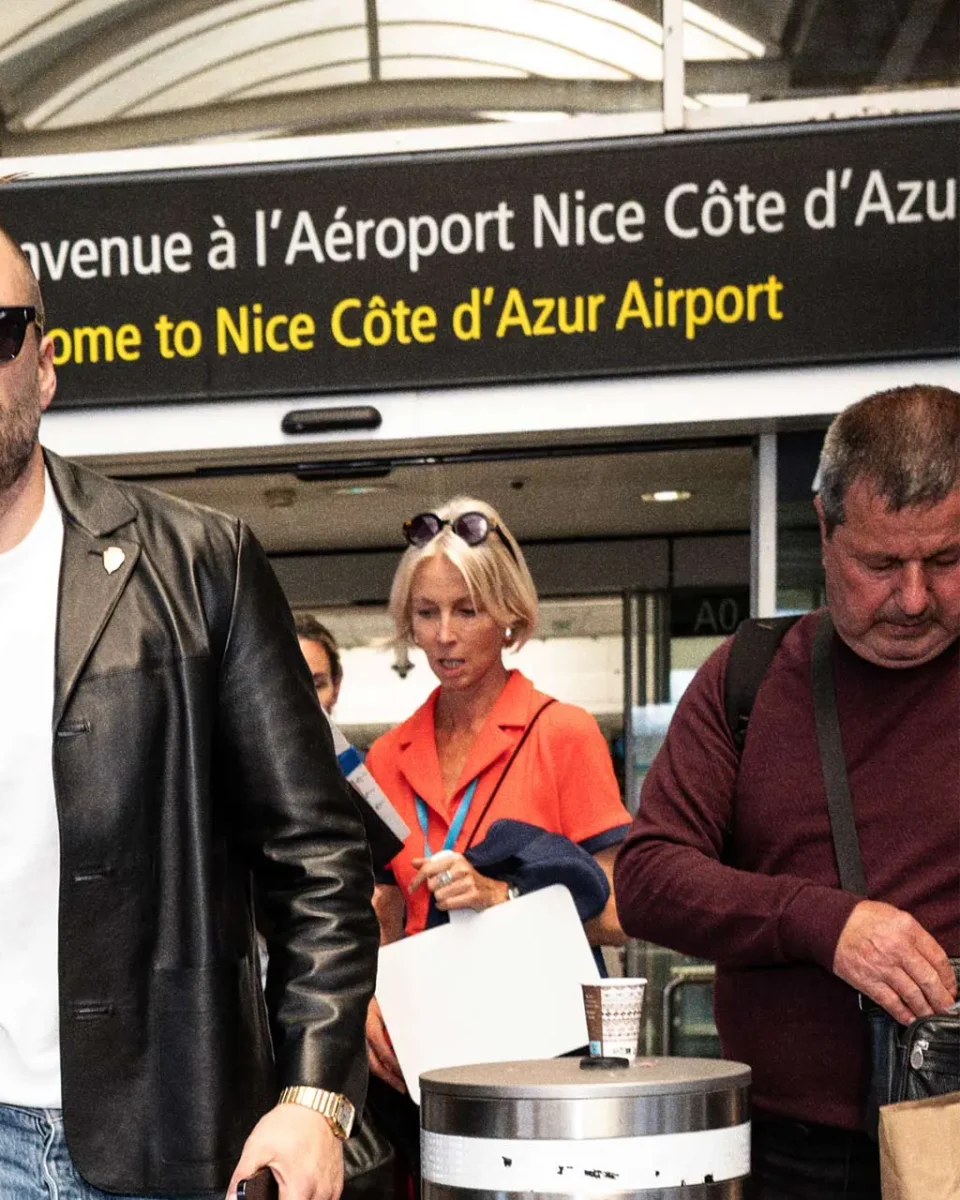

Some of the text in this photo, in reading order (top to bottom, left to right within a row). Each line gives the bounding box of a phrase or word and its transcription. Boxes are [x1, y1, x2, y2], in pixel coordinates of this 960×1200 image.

[20, 168, 957, 281] nvenue à l'Aéroport Nice Côte d'Azu
[154, 314, 202, 359] to
[216, 303, 316, 356] Nice
[330, 295, 438, 348] Côte
[452, 286, 606, 341] d'Azur
[615, 275, 784, 340] Airport
